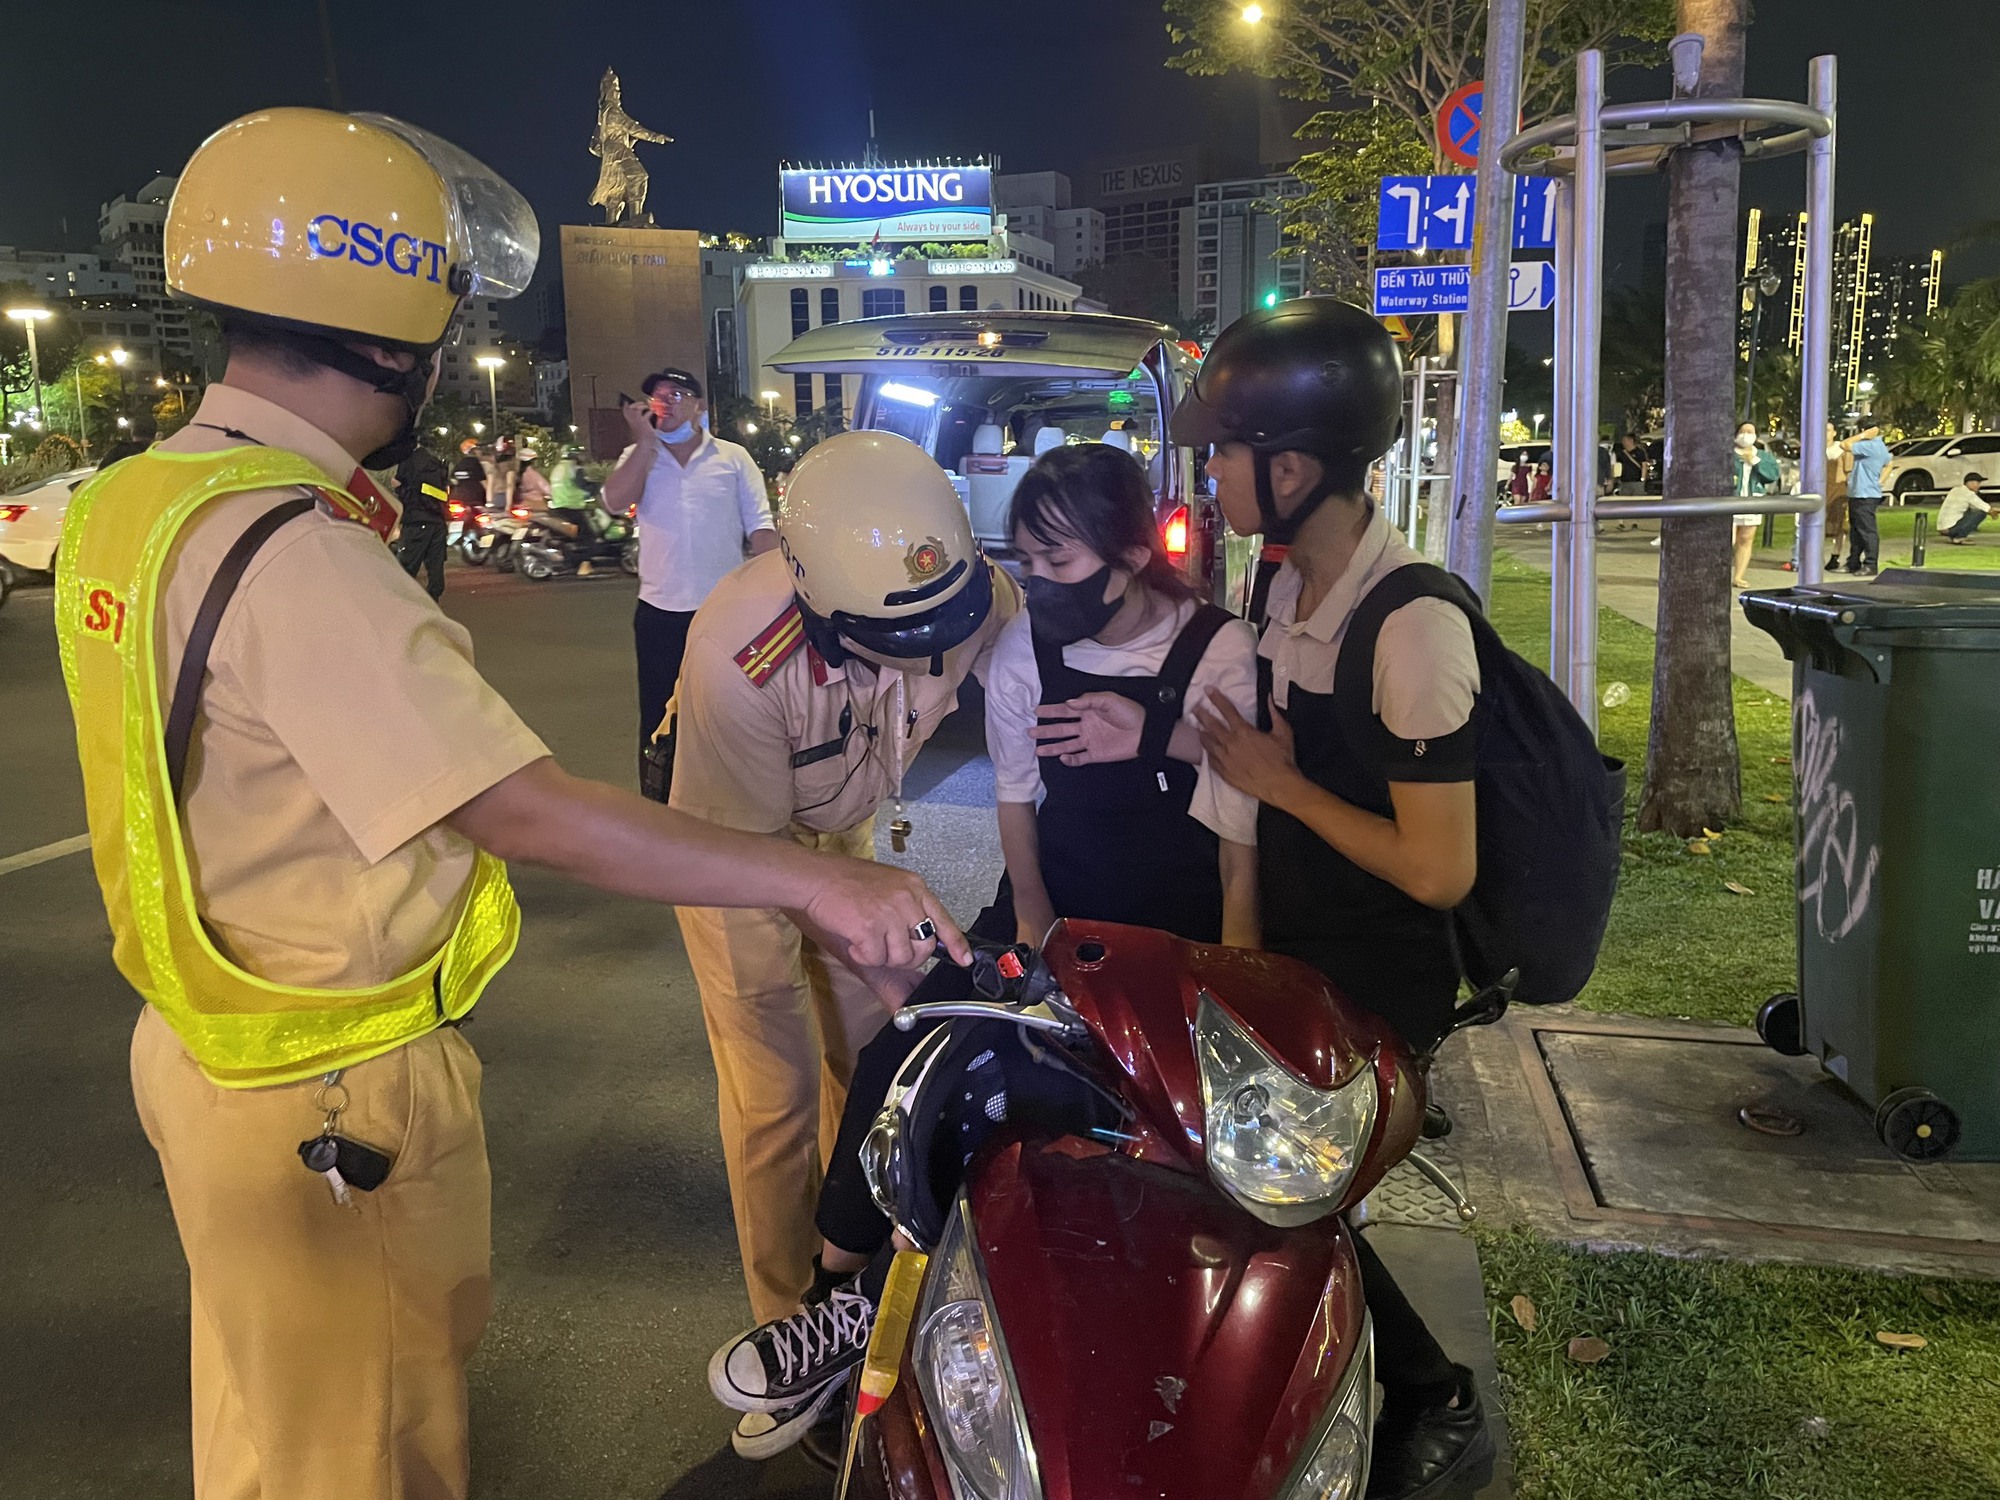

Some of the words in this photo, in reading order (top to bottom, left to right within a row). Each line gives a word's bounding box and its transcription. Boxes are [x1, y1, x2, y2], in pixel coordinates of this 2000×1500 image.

[809, 173, 963, 203] HYOSUNG
[1102, 170, 1125, 193] THE
[1132, 162, 1183, 189] NEXUS
[897, 221, 928, 232] Always
[929, 221, 940, 233] by
[942, 222, 961, 232] your
[962, 220, 981, 231] side
[306, 214, 447, 284] CSGT
[1380, 268, 1406, 288] BẾN
[1411, 269, 1435, 287] TÀU
[1380, 295, 1428, 308] Waterway
[1432, 293, 1468, 305] Station
